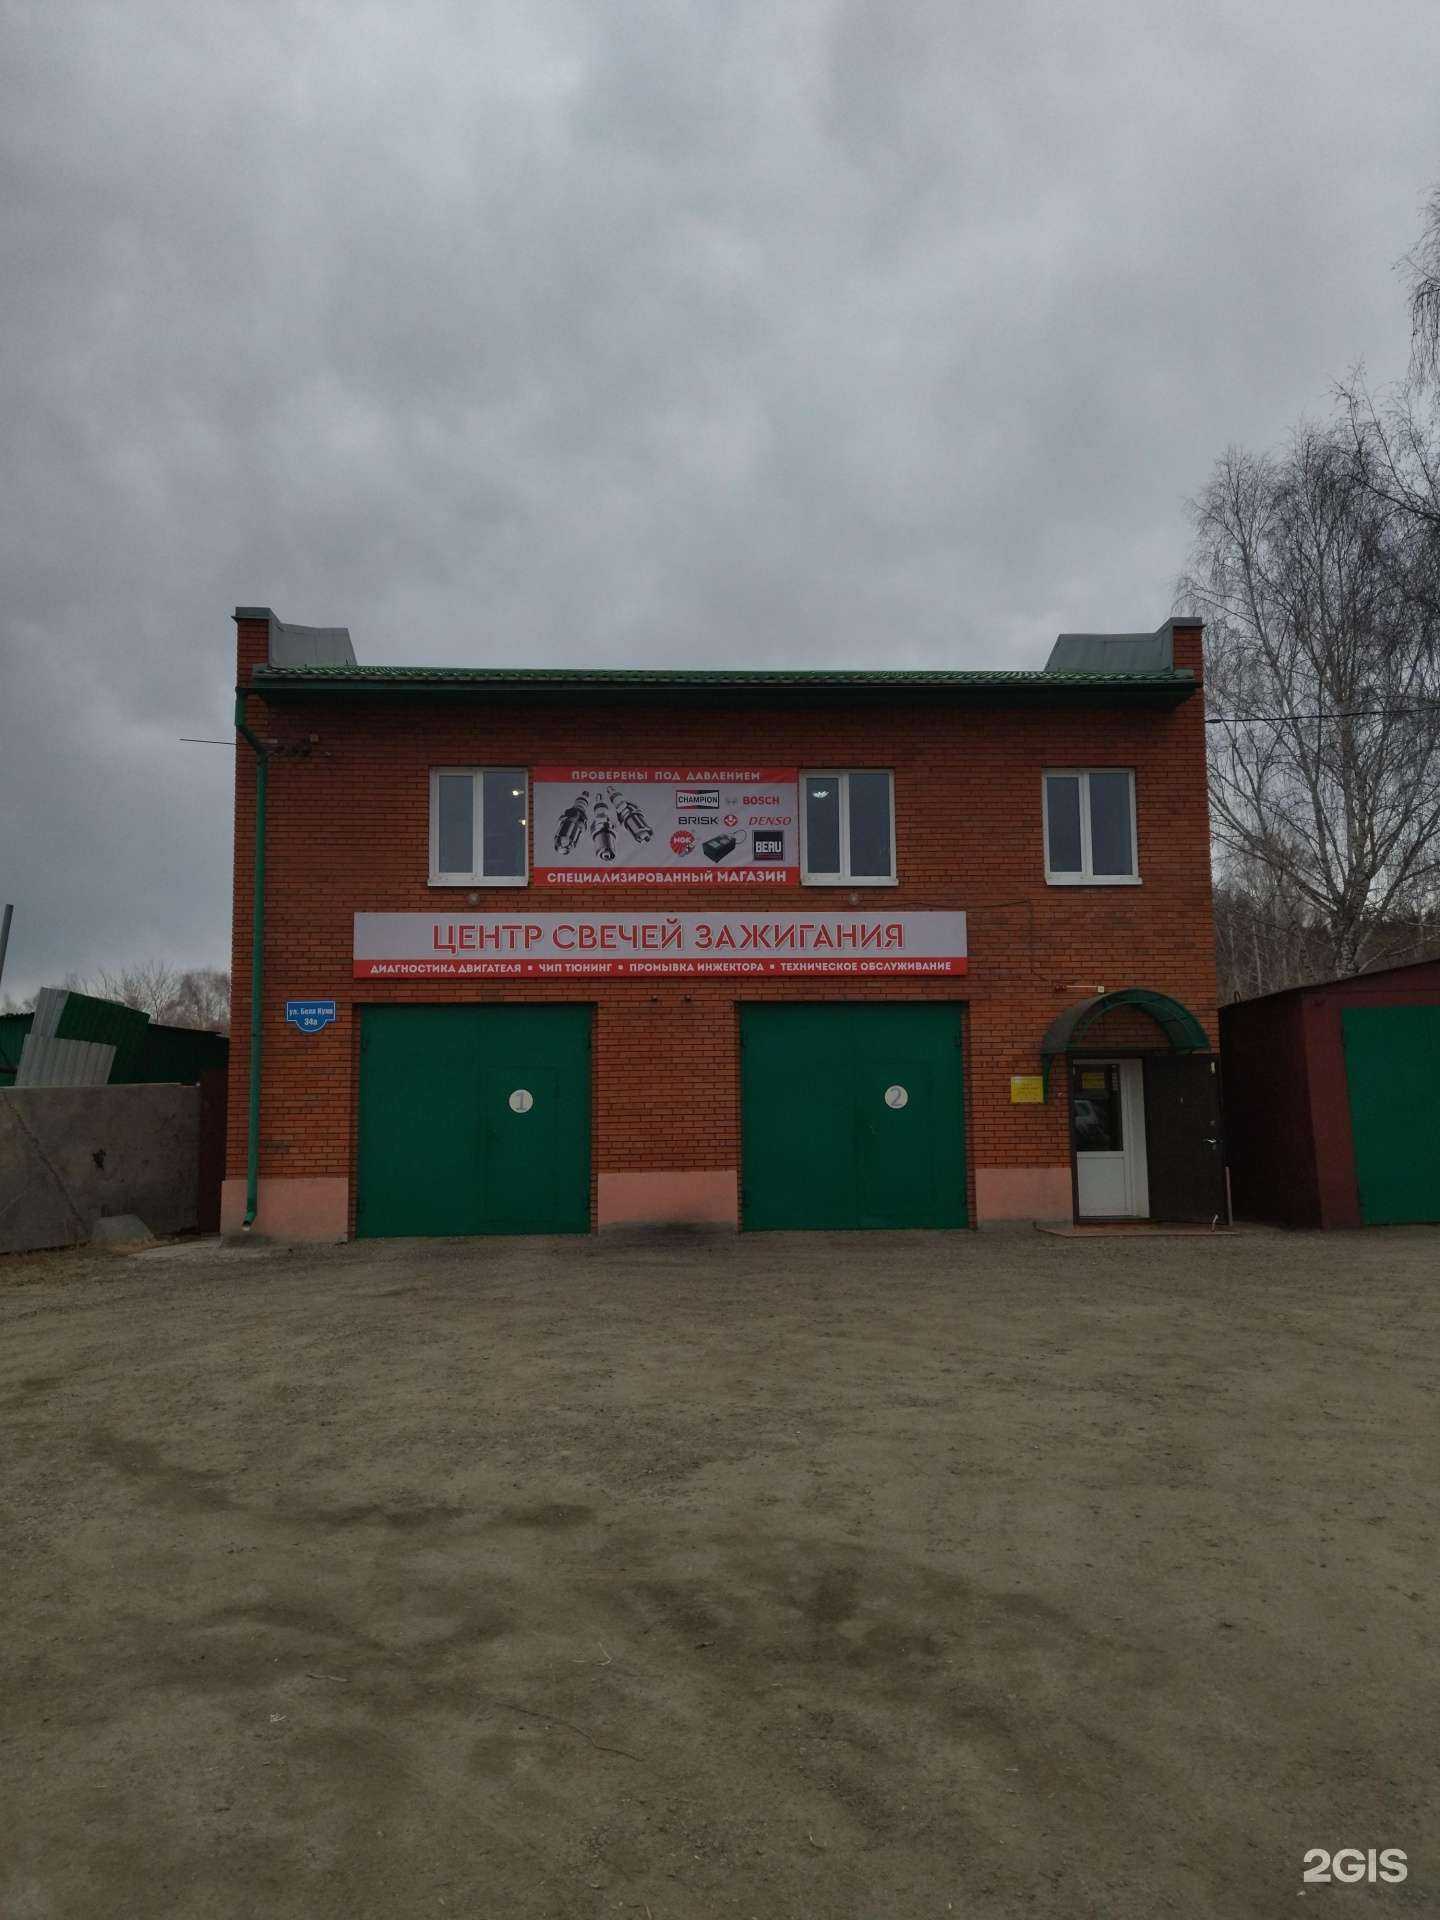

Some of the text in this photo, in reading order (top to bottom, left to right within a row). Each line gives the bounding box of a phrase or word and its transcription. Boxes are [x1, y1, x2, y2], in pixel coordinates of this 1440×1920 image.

[572, 771, 761, 781] ПРОВЕРЕНЫ ПОД ДАВЛЕНИЕМ
[677, 795, 718, 804] CHAMPION
[743, 796, 780, 805] BOSCH
[678, 816, 719, 825] BRISK
[748, 816, 792, 825] DENSO
[755, 841, 782, 853] BERU
[547, 870, 787, 883] СПЕЦИАЛИЗИРОВАННЫЙ МАГАЗИН
[433, 917, 905, 956] ЦЕНТР СВЕЧЕЙ ЗАЖИГАНИЯ
[370, 961, 952, 974] ДИАГНОСТИКА ДВИГАТЕЛЯ ЧИП ТЮНИНГ ПРОМЫВКА ИНЖЕКТОРА ТЕХНИЧЕСКОЕ ОБСЛУЖИВАНИЕ
[890, 1088, 902, 1106] 2
